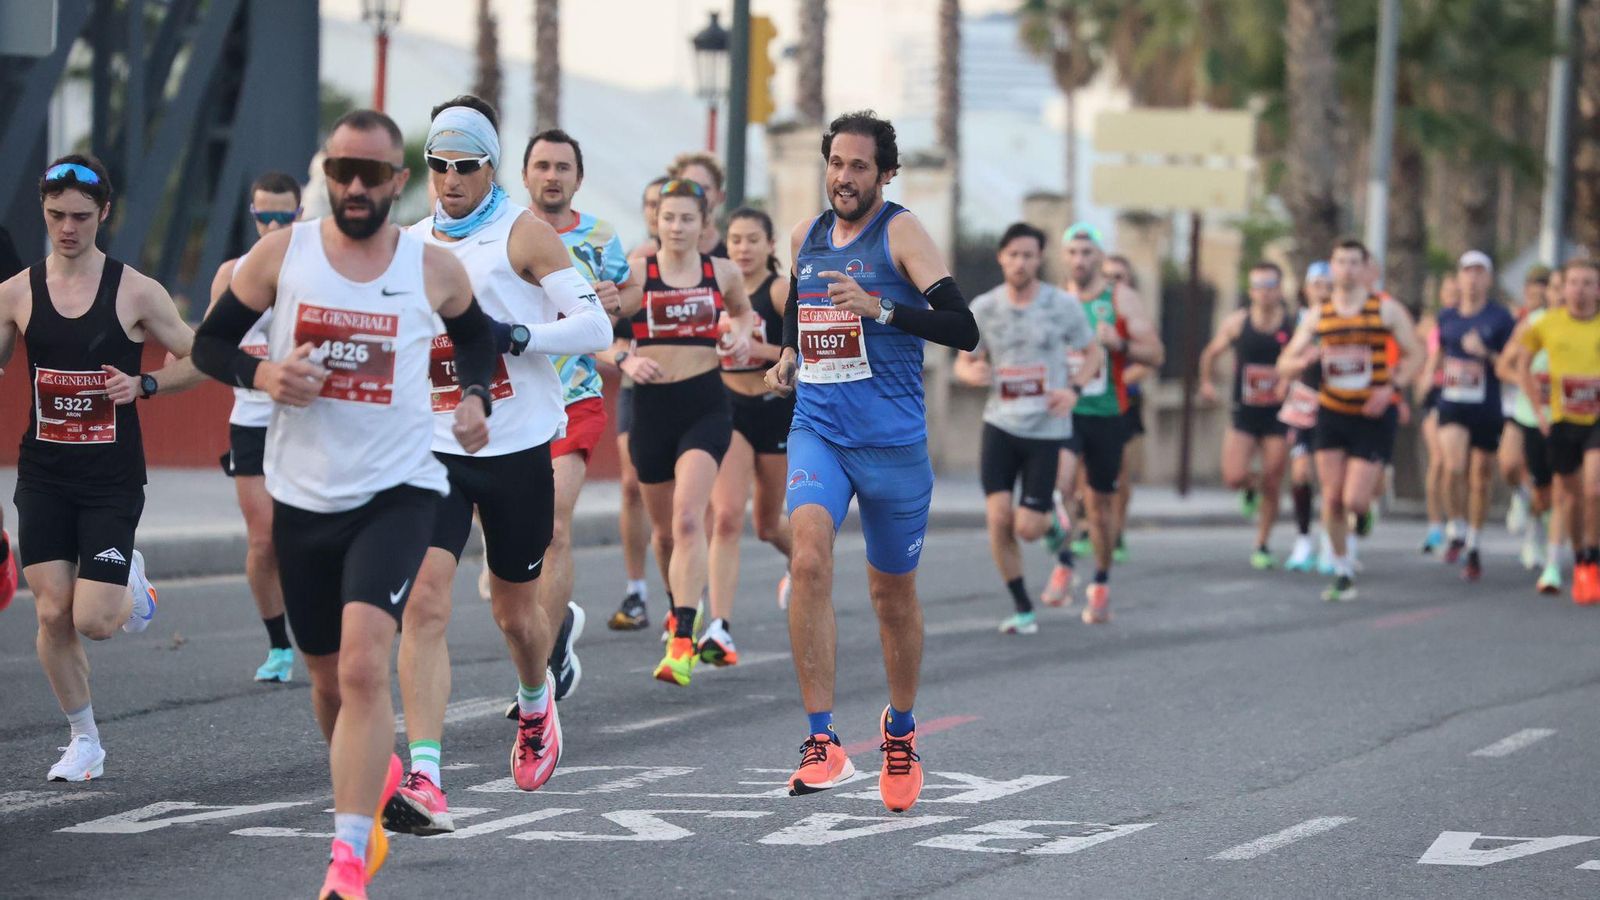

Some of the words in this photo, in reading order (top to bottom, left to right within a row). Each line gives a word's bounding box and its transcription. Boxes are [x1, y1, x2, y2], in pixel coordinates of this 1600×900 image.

[665, 303, 698, 318] 5847
[322, 310, 392, 332] GENERALI
[807, 334, 846, 349] 11697
[319, 340, 370, 363] 4826
[54, 396, 93, 411] 5322
